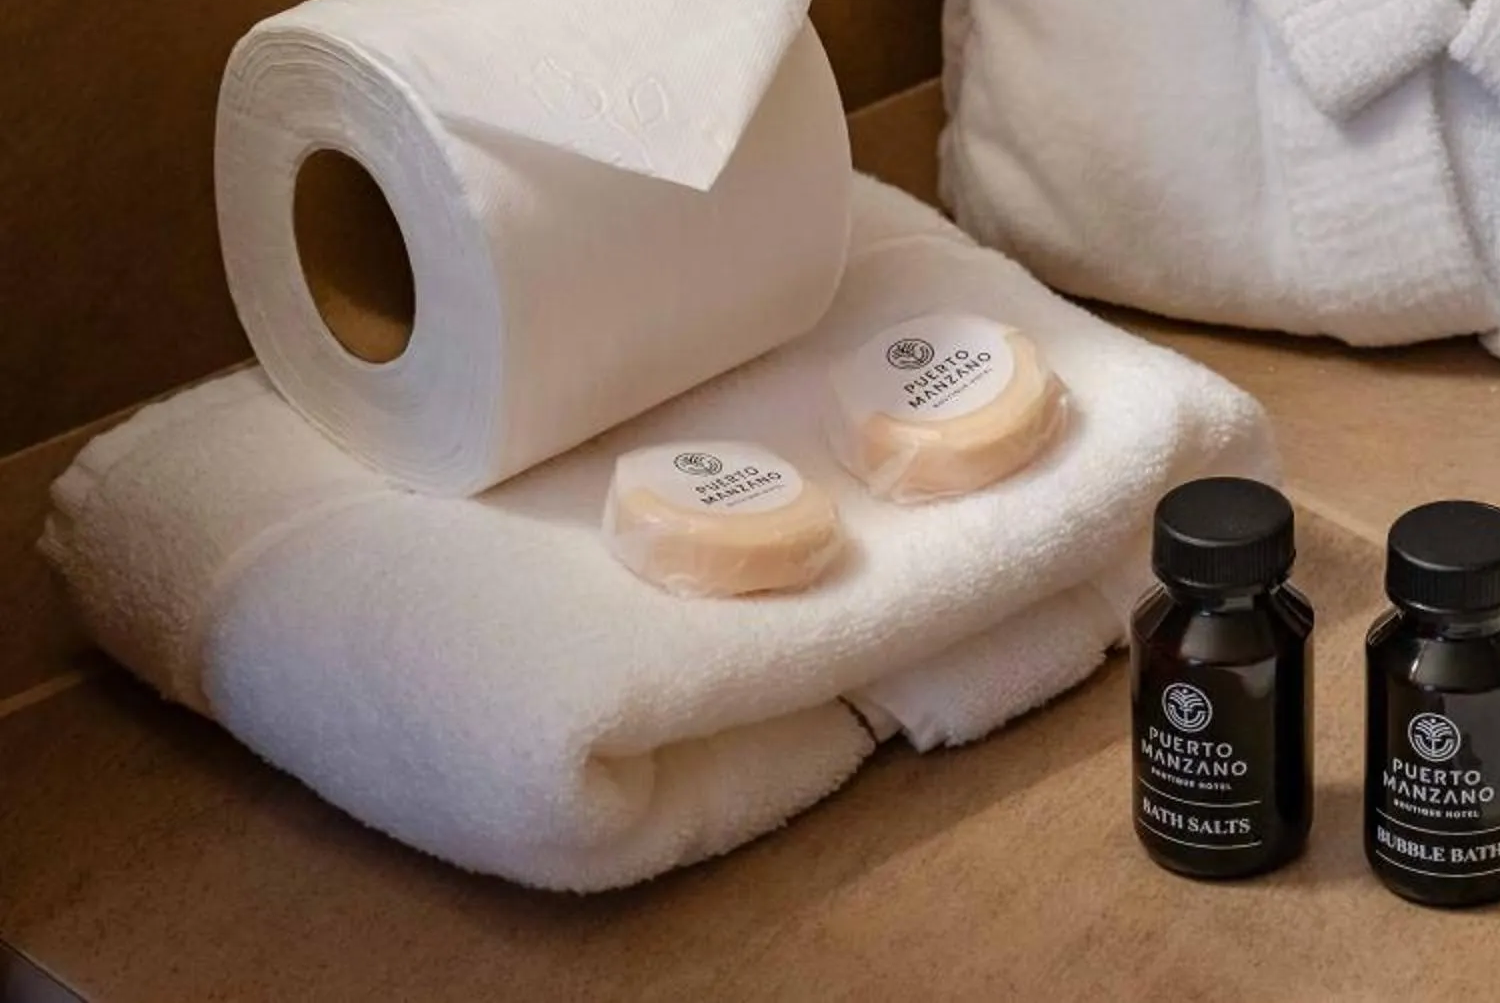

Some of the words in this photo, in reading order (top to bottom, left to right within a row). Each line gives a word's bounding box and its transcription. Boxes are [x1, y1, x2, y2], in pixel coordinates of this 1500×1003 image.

[904, 350, 969, 393] PUERTO
[908, 352, 991, 409] MANZANO
[695, 466, 759, 494] PUERTO
[701, 472, 781, 504] MANZANO
[1141, 738, 1248, 776] MANZANO
[1149, 726, 1232, 758] PUERTO
[1199, 782, 1232, 791] HOTEL
[1383, 770, 1494, 805] MANZANO
[1393, 757, 1481, 786] PUERTO
[1143, 797, 1183, 829] BATH
[1187, 818, 1251, 834] SALTS
[1445, 810, 1480, 819] HOTEL
[1377, 825, 1446, 862] BUBBLE
